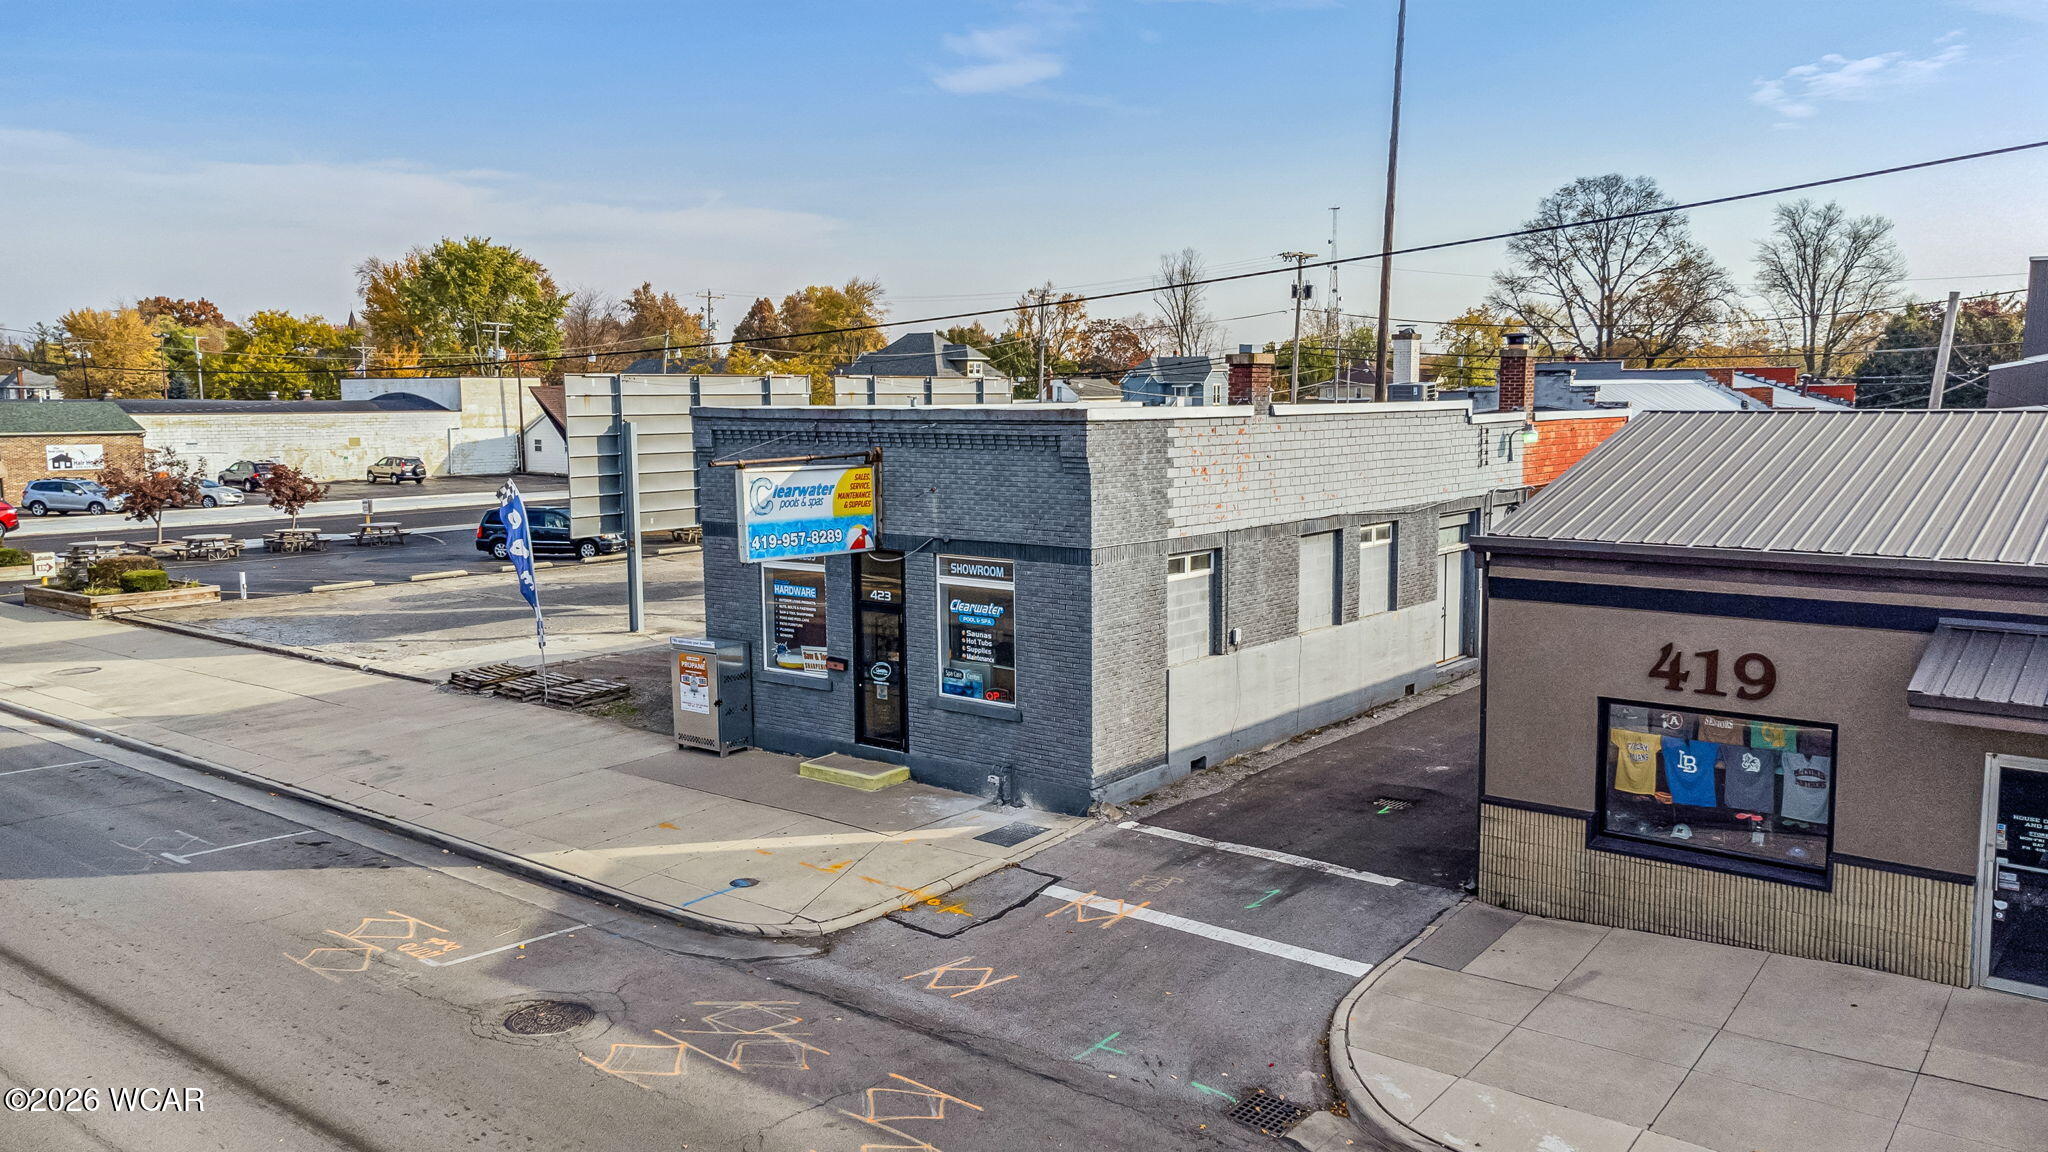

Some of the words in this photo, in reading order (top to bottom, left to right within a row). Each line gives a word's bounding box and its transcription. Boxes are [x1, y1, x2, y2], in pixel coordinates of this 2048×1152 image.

[750, 477, 835, 516] Clearwater
[838, 491, 871, 500] MAINTENANCE
[779, 498, 799, 510] pools
[800, 498, 807, 507] &
[808, 497, 824, 508] spas
[751, 528, 843, 550] 419-957-8289
[950, 562, 1004, 578] SHOWROOM
[774, 584, 816, 597] HARDWARE
[870, 590, 892, 601] 423
[950, 599, 1004, 615] Clearwater
[966, 630, 992, 639] Saunas
[966, 646, 992, 654] Supplies
[966, 653, 995, 663] Maintenance
[682, 661, 705, 670] PROPANE
[1648, 642, 1776, 700] 419
[1677, 750, 1697, 773] LB
[2013, 815, 2041, 823] HOUSE
